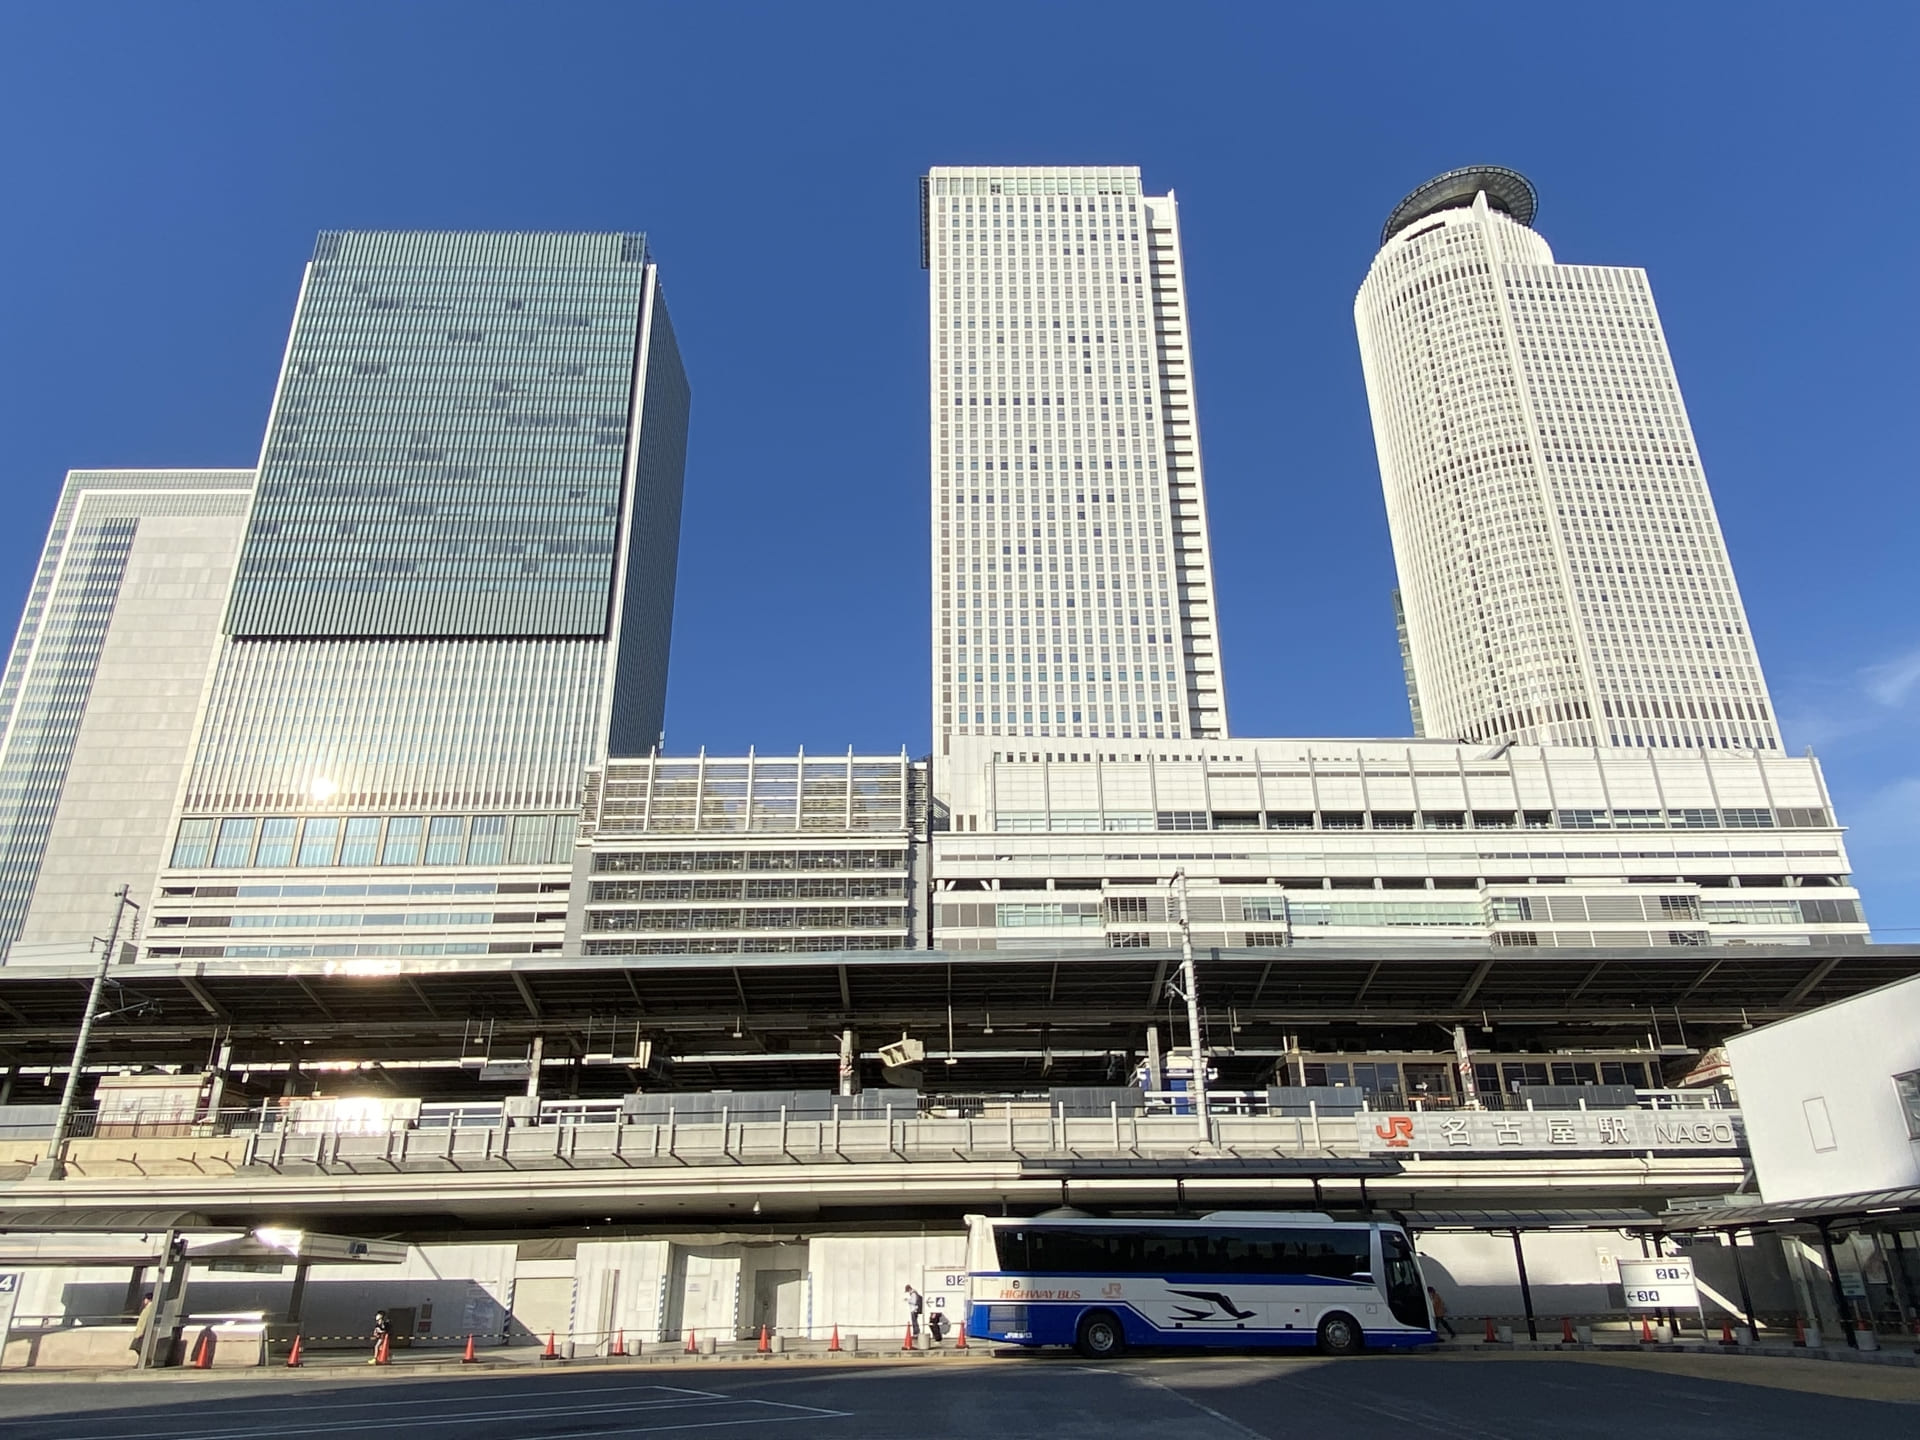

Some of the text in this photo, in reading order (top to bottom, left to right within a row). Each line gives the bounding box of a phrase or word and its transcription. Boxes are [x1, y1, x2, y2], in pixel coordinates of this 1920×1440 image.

[1376, 1116, 1732, 1146] JR 名古屋駅 NAGO
[1657, 1269, 1666, 1279] 2
[0, 1275, 13, 1291] 4
[1000, 1289, 1081, 1299] HIGHWAY BUS
[1101, 1283, 1122, 1296] JR
[1638, 1291, 1659, 1301] 3 4
